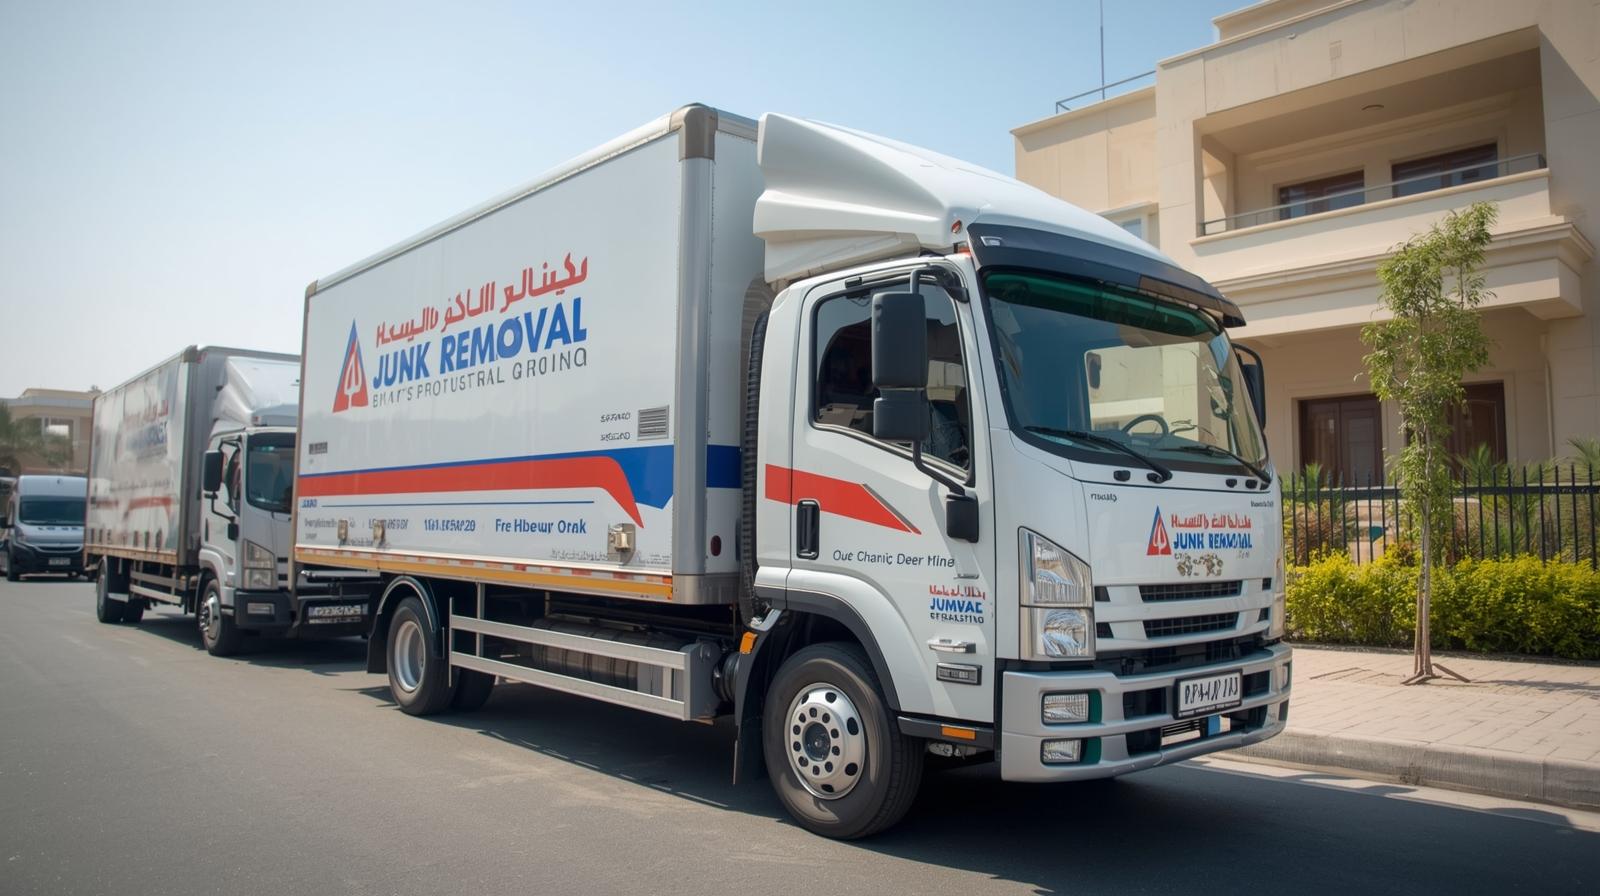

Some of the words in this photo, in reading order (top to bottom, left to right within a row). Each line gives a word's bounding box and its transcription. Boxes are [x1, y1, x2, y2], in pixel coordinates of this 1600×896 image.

[373, 341, 431, 389] JUNK
[440, 297, 587, 375] REMOVAL
[896, 553, 924, 565] Deer
